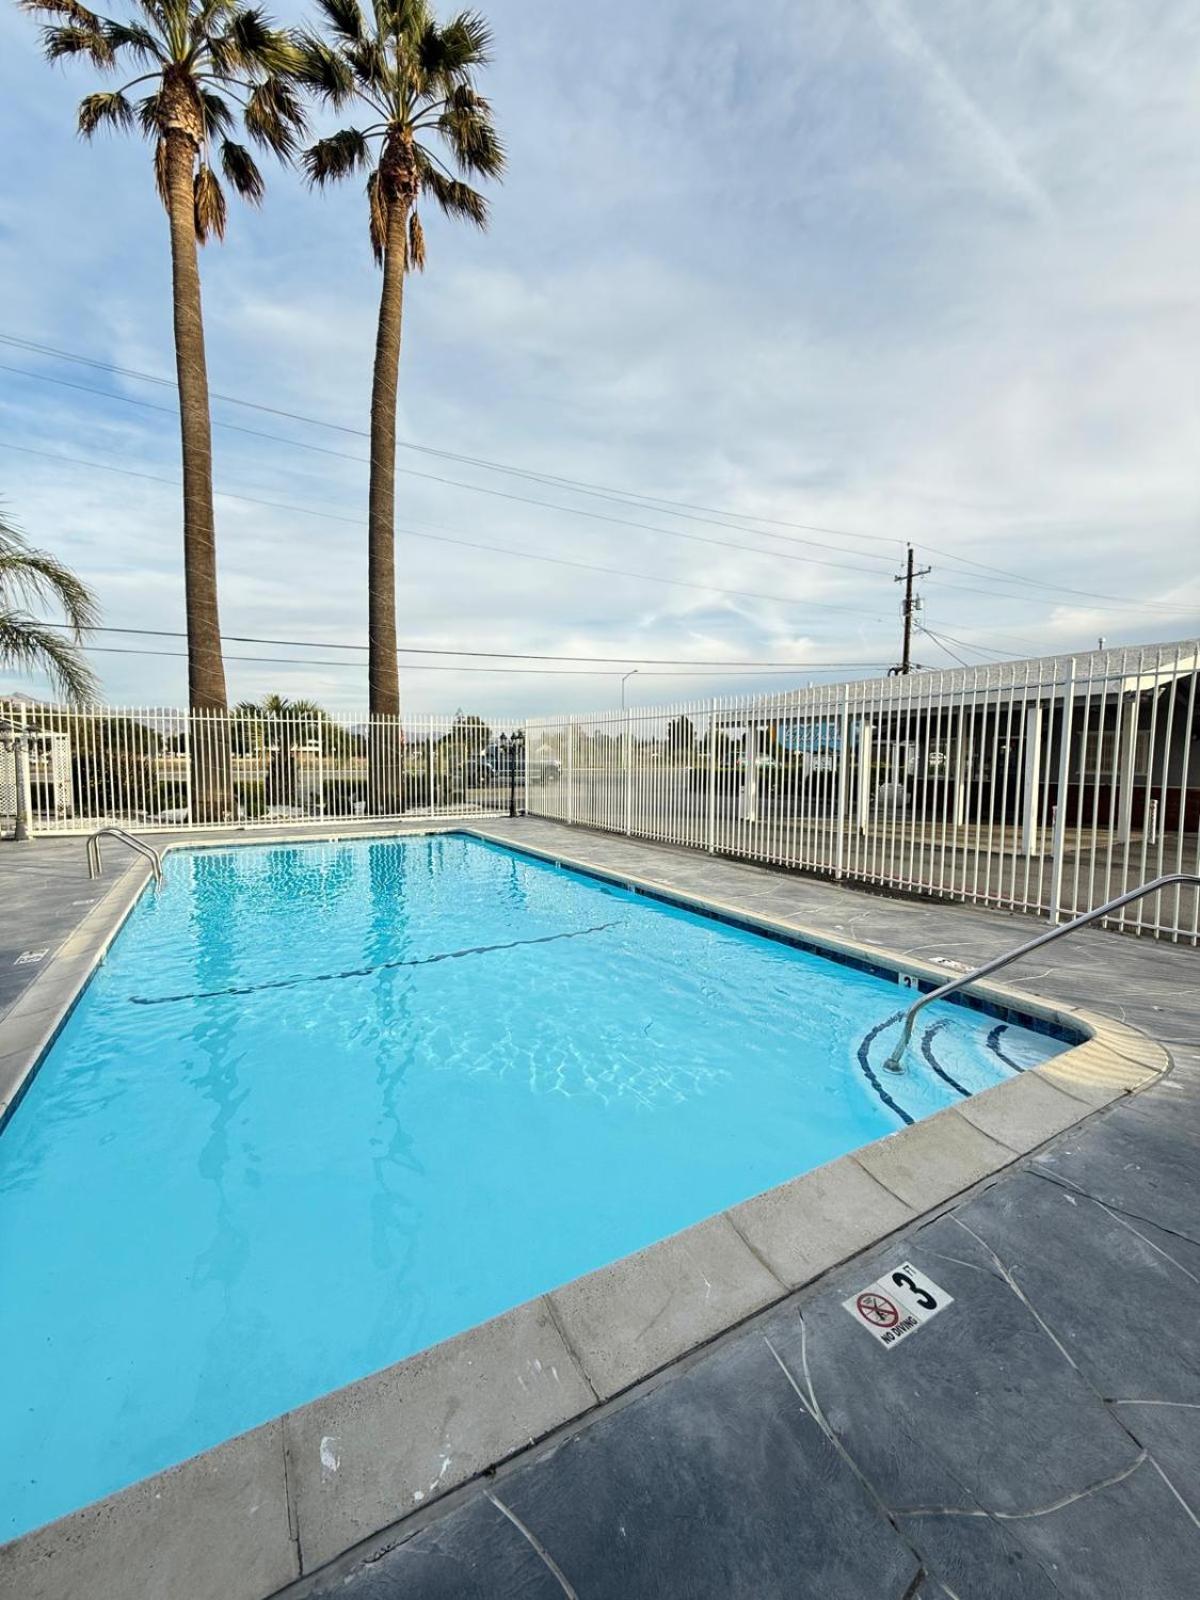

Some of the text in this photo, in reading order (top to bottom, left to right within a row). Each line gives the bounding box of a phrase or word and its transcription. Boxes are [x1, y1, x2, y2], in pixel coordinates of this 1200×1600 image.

[892, 1272, 937, 1310] 3
[880, 1315, 918, 1344] NO DIVING
